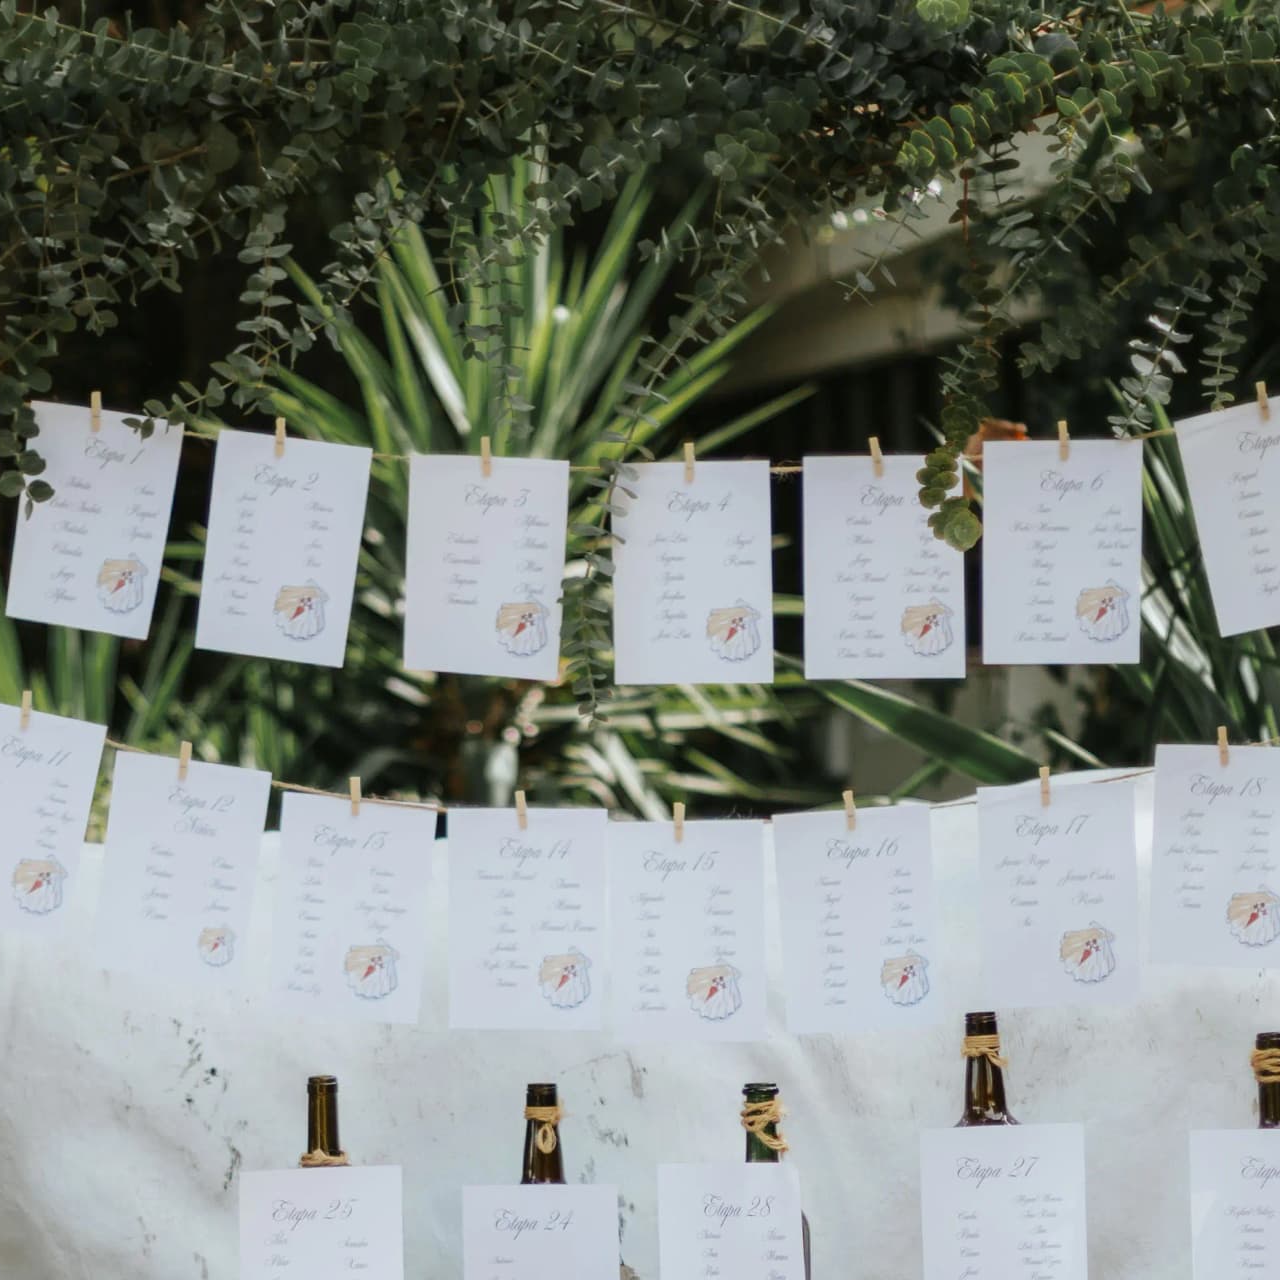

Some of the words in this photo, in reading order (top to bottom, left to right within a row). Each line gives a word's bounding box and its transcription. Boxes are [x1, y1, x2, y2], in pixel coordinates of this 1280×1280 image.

[85, 436, 125, 469] Etapa
[130, 448, 145, 464] 1
[1237, 430, 1280, 460] Etapa
[253, 465, 297, 490] Etapa
[296, 471, 319, 492] 2
[1040, 470, 1083, 500] Etapa
[1089, 471, 1110, 491] 6
[465, 484, 507, 515] Etapa
[668, 491, 710, 521] Etapa
[715, 492, 732, 512] 4
[860, 486, 905, 516] Etapa
[1, 736, 43, 768] Etapa
[49, 751, 70, 767] 11
[168, 785, 206, 815] Etapa
[210, 795, 234, 813] 12
[1190, 775, 1233, 805] Etapa
[1239, 777, 1267, 795] 18
[314, 824, 356, 856] Etapa
[1015, 815, 1058, 845] Etapa
[1065, 815, 1092, 837] 17
[499, 837, 542, 868] Etapa
[546, 839, 573, 859] 14
[643, 851, 686, 882] Etapa
[691, 852, 720, 872] 15
[826, 838, 869, 869] Etapa
[876, 838, 899, 858] 16
[956, 1157, 1001, 1189] Etapa
[1008, 1157, 1040, 1177] 27
[272, 1198, 318, 1231] Etapa
[323, 1198, 358, 1220] 25
[495, 1207, 537, 1240] Etapa
[543, 1211, 574, 1231] 24
[703, 1194, 742, 1228] Etapa
[747, 1196, 773, 1218] 28
